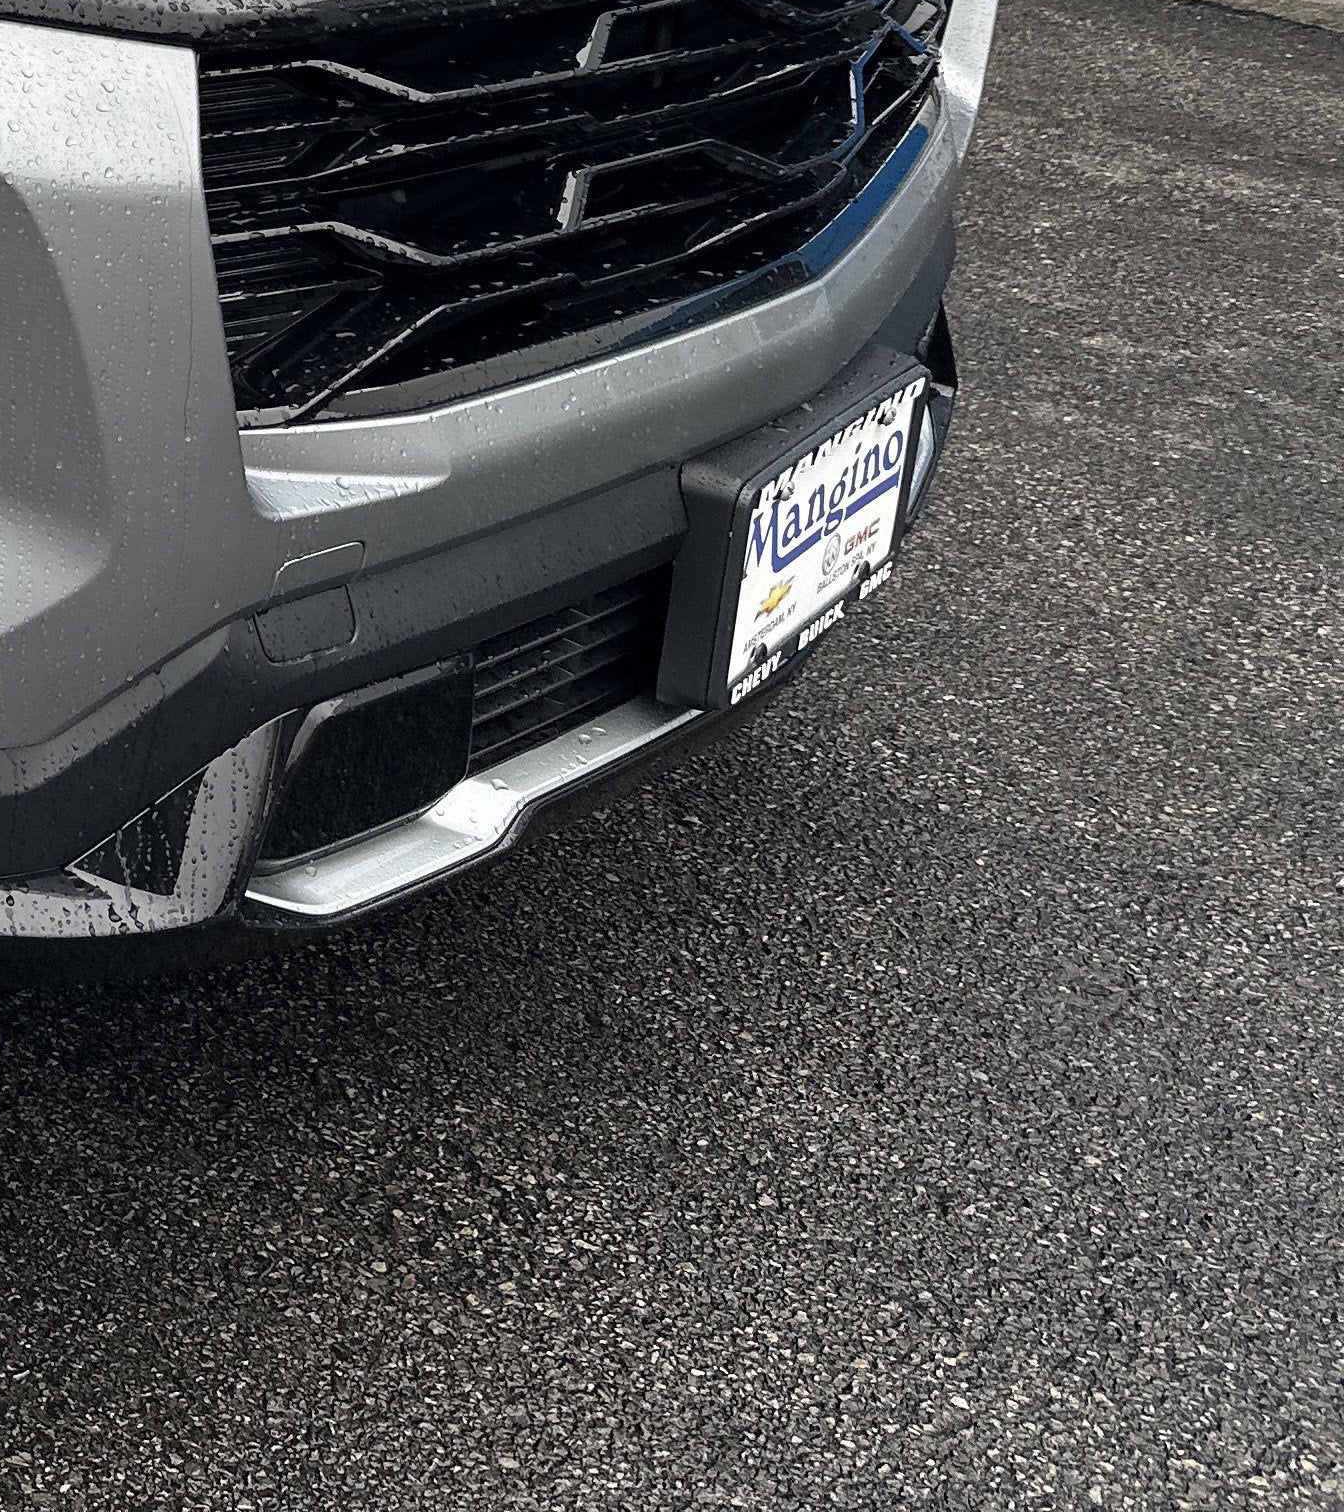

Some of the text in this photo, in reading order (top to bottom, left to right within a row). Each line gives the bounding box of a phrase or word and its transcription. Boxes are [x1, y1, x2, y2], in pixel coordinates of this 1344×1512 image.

[743, 430, 904, 572] Mangino
[843, 517, 881, 556] GMC
[731, 561, 893, 705] CHEVY BUICK GMC
